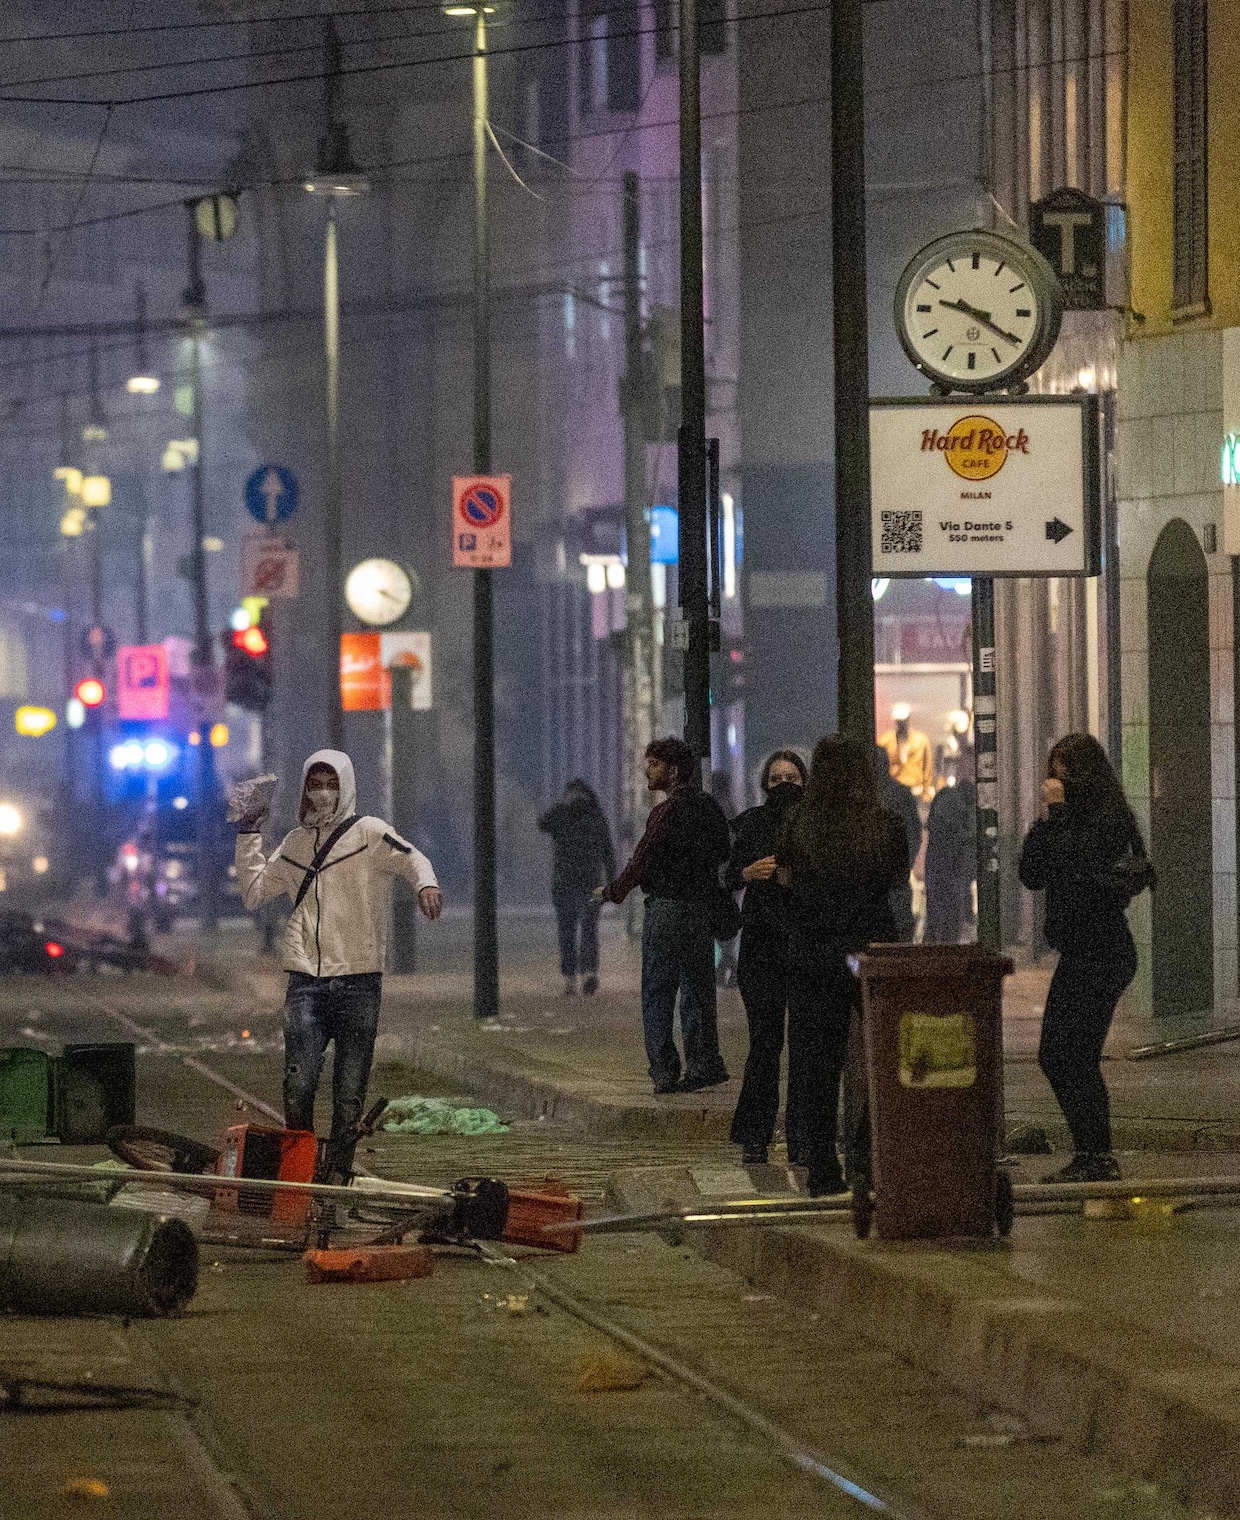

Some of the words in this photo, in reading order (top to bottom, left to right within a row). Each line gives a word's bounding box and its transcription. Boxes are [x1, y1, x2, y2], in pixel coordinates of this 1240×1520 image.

[921, 428, 976, 452] Hard
[977, 428, 1030, 455] Rock
[962, 459, 990, 469] CAFE
[960, 492, 992, 500] MILAN
[939, 521, 961, 531] Via
[964, 521, 1002, 531] Dante
[1005, 521, 1013, 531] 5
[949, 534, 968, 542] 550
[971, 534, 1005, 542] meters
